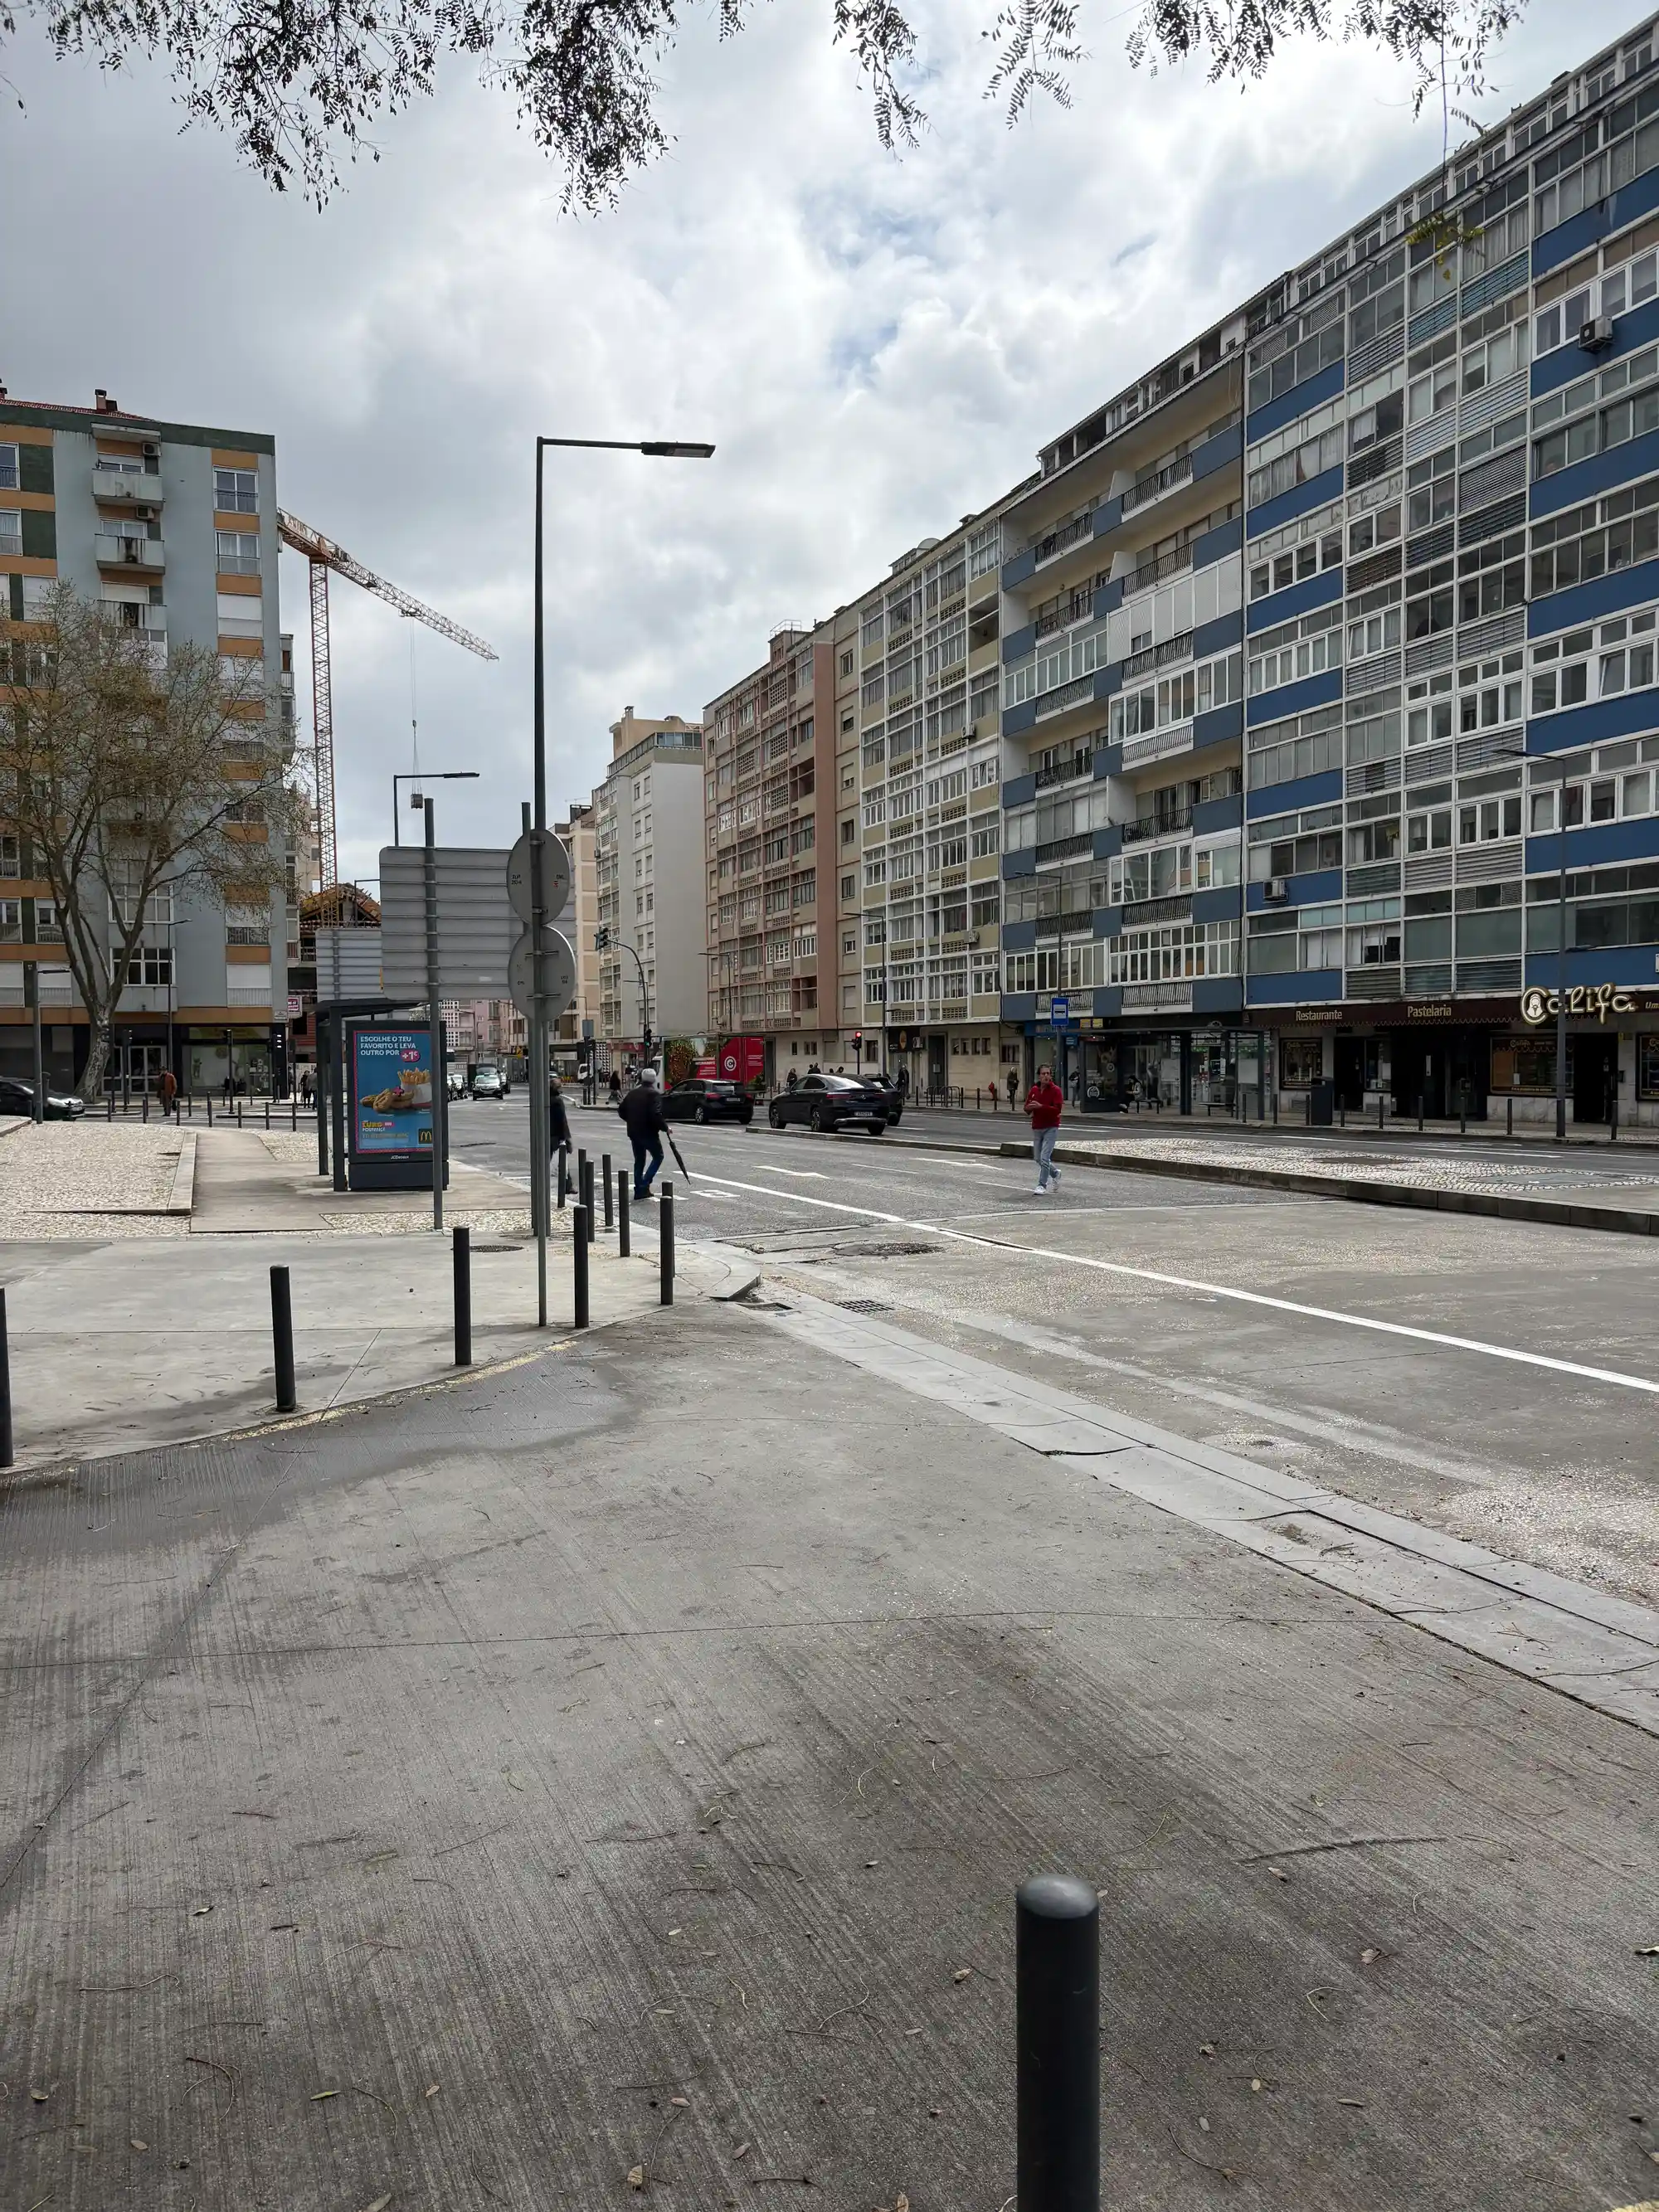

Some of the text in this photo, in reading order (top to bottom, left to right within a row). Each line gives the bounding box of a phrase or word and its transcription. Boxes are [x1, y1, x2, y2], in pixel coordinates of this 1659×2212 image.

[1520, 982, 1638, 1025] Califa
[1296, 1009, 1343, 1021] Restaurante
[1408, 1004, 1452, 1018] Pastelaria
